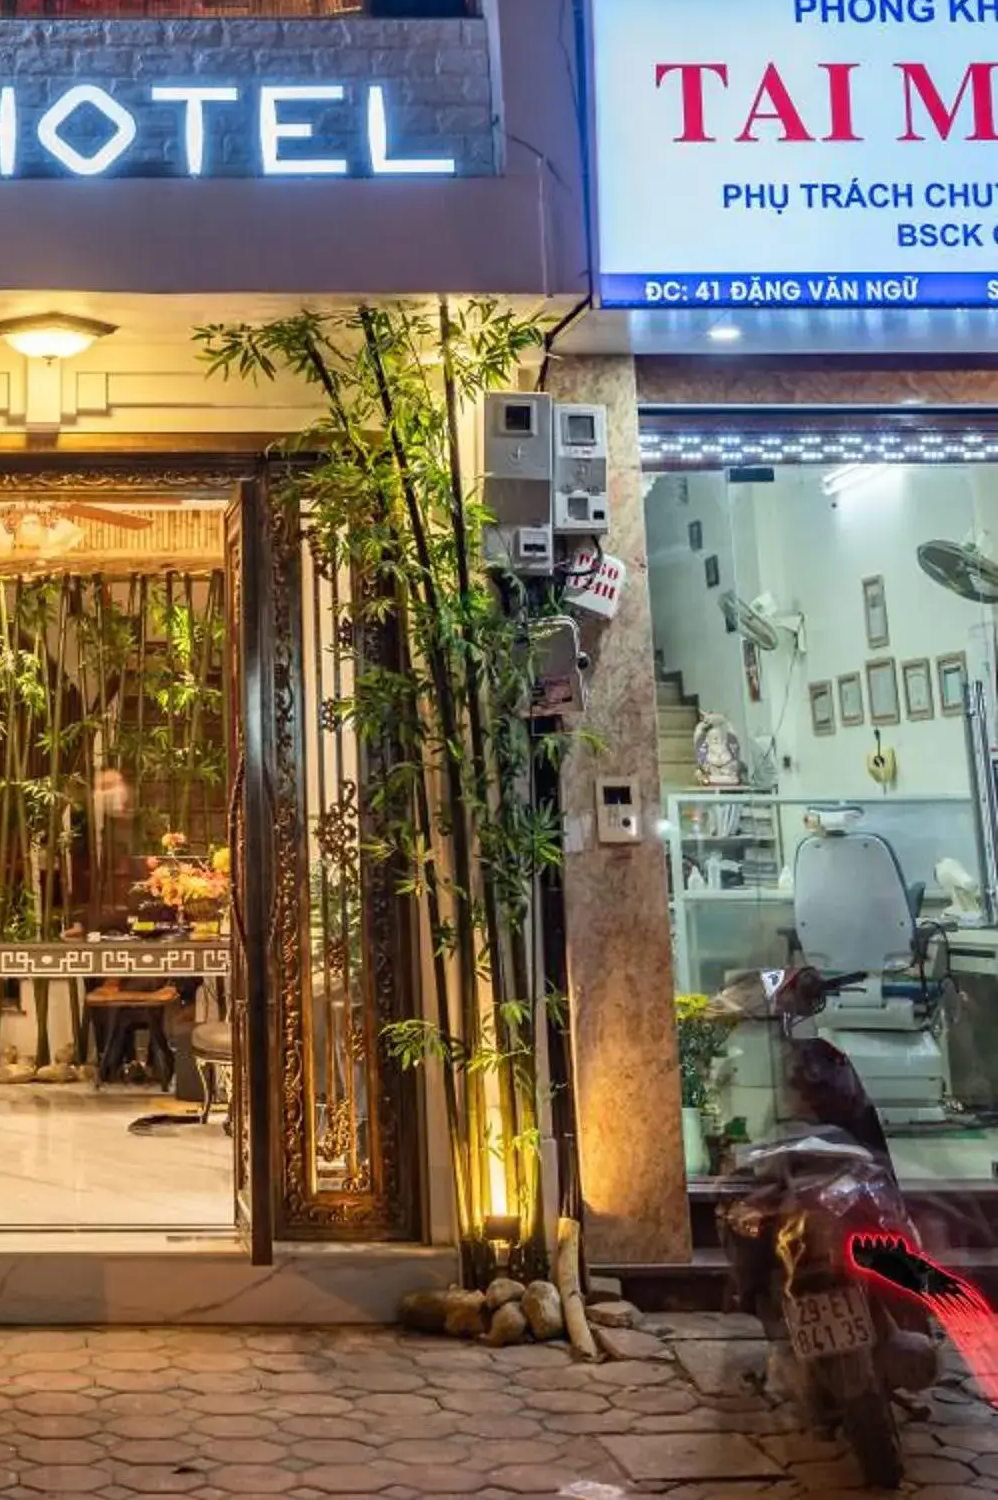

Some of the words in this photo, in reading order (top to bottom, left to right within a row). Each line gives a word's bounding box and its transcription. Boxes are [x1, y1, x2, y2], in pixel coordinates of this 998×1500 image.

[655, 62, 865, 143] TAI
[893, 62, 998, 142] M
[722, 184, 790, 215] PHỤ
[800, 178, 913, 209] TRÁCH
[897, 224, 983, 247] BSCK
[644, 281, 688, 302] ĐC:
[695, 280, 720, 300] 41
[730, 277, 801, 307] ĐẶNG
[809, 277, 858, 301] VĂN
[866, 276, 919, 301] NGỮ
